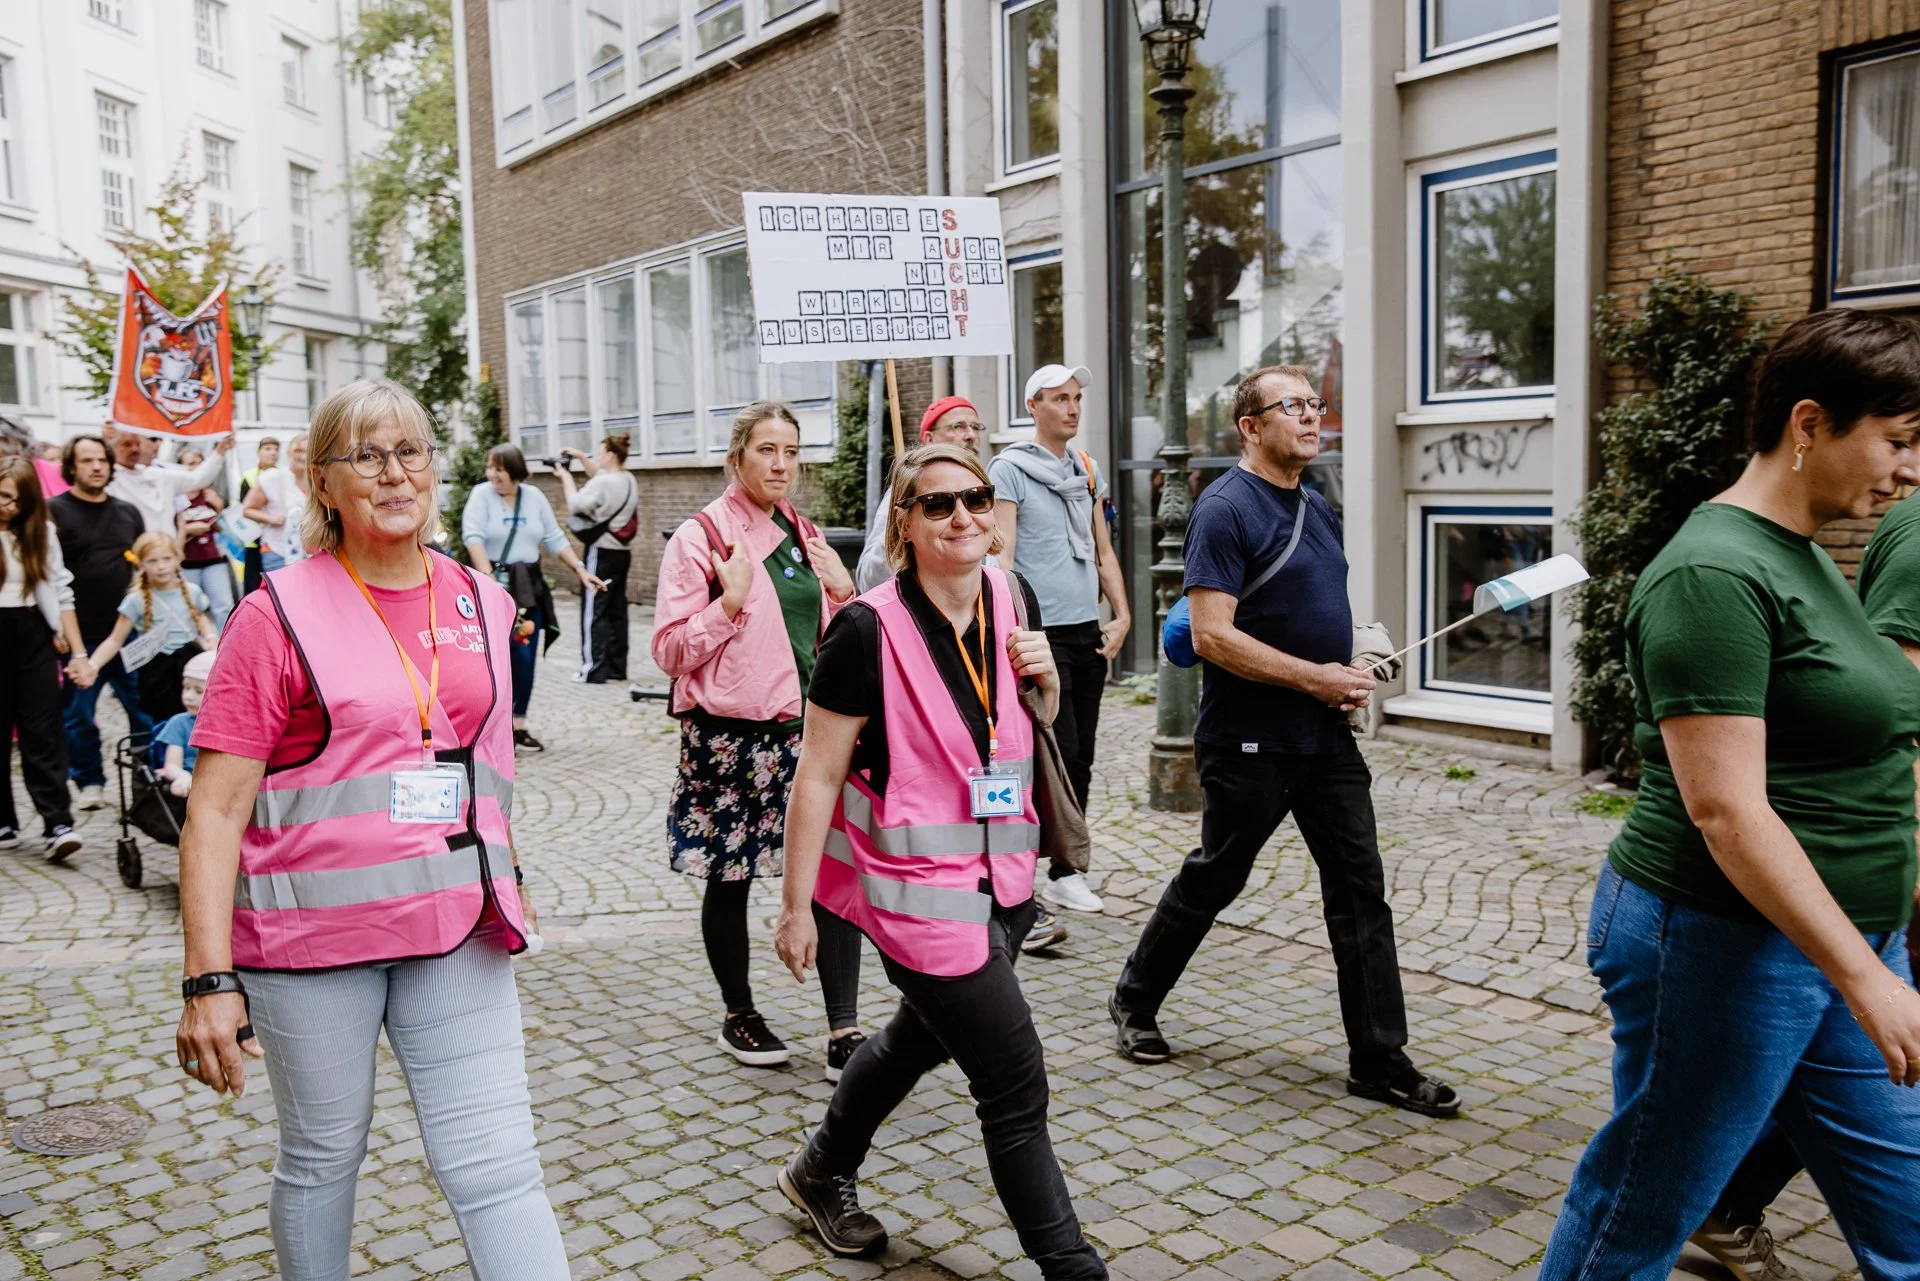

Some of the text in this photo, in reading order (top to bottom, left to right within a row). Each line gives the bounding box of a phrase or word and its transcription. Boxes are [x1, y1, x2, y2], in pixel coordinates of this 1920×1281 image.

[763, 208, 958, 231] ICH HABE ES
[830, 238, 998, 259] MIR AUCH
[908, 263, 1000, 284] NICHT
[801, 289, 968, 314] WIRKLICH
[763, 315, 967, 342] AUSGESUCHT
